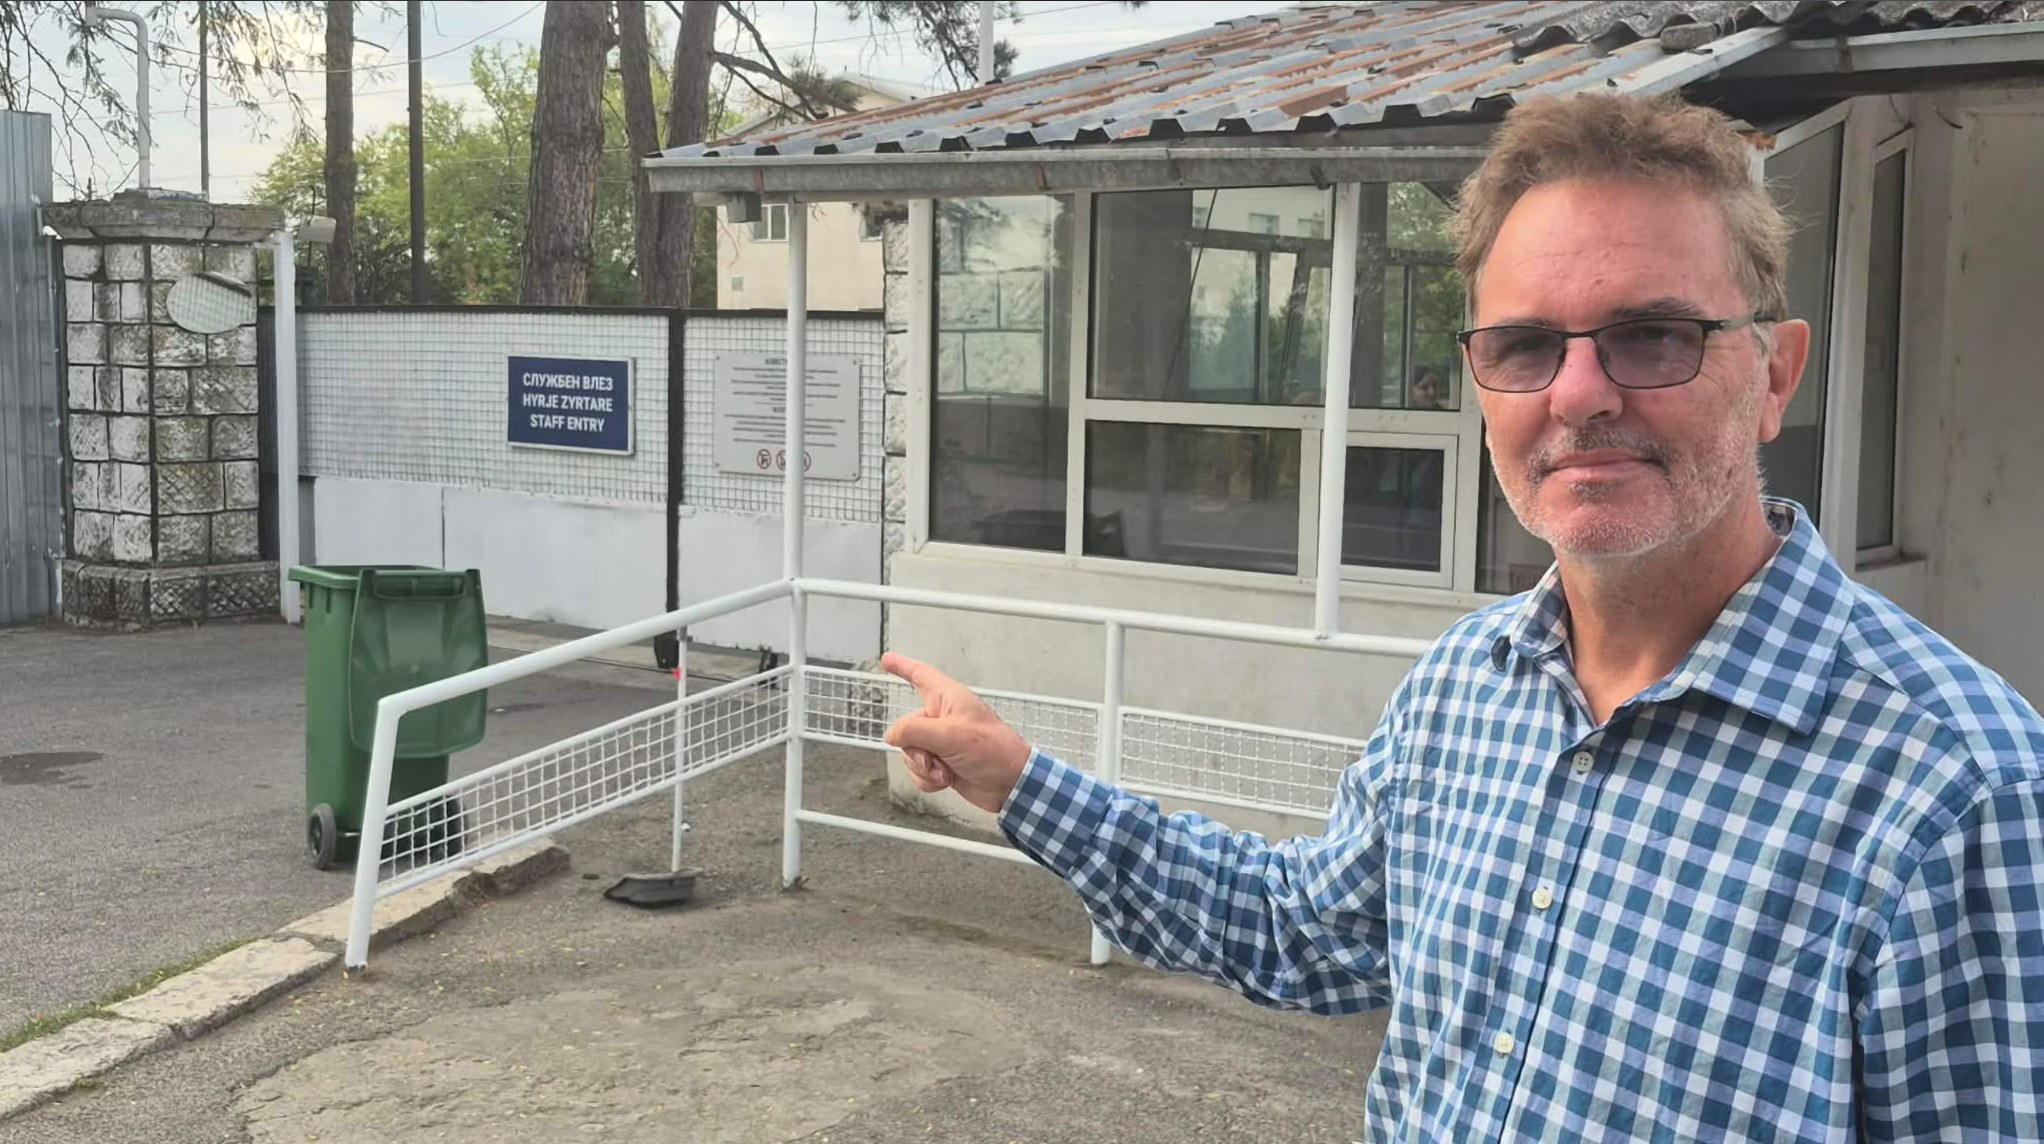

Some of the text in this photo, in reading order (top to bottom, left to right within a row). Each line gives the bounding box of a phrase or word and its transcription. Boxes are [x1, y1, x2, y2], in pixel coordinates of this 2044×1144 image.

[523, 373, 614, 391] СЛУЖБЕН ВЛЕЗ
[523, 393, 614, 412] HYRJE ZYRTARE
[530, 414, 605, 432] STAFF ENTRY
